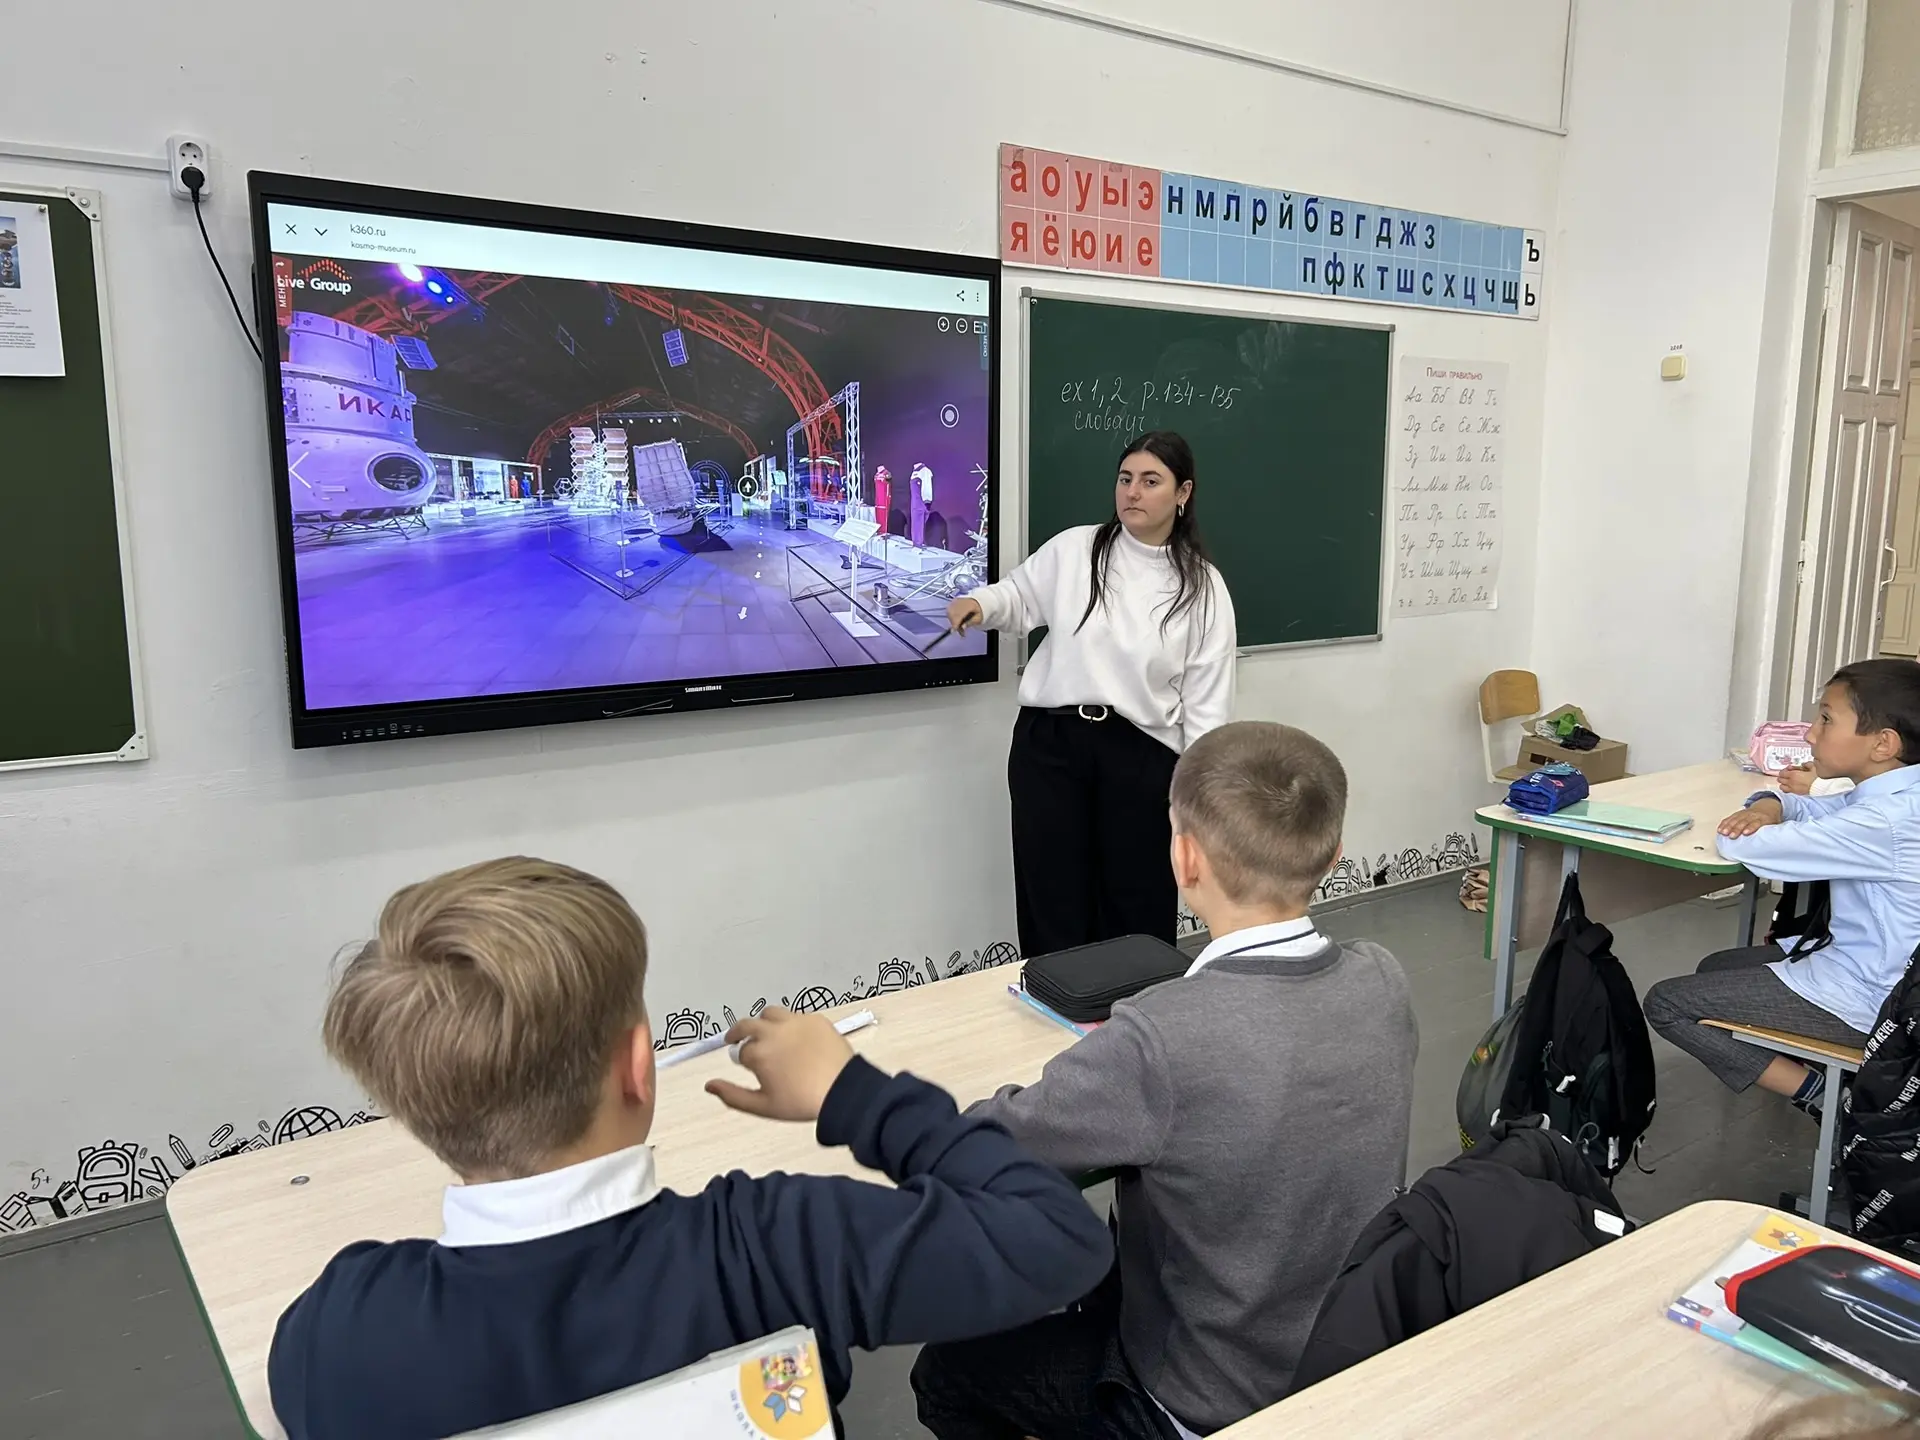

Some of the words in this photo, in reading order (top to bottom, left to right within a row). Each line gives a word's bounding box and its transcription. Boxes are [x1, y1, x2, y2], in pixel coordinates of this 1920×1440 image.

[350, 223, 386, 237] k360.ru
[350, 241, 416, 254] kosmo-museum.ru
[310, 277, 352, 296] Group
[1061, 380, 1084, 403] ex
[338, 392, 412, 423] ИКАР
[1874, 1018, 1899, 1044] NEVER
[1898, 1076, 1920, 1103] NEVER
[1869, 1188, 1895, 1213] NEVER
